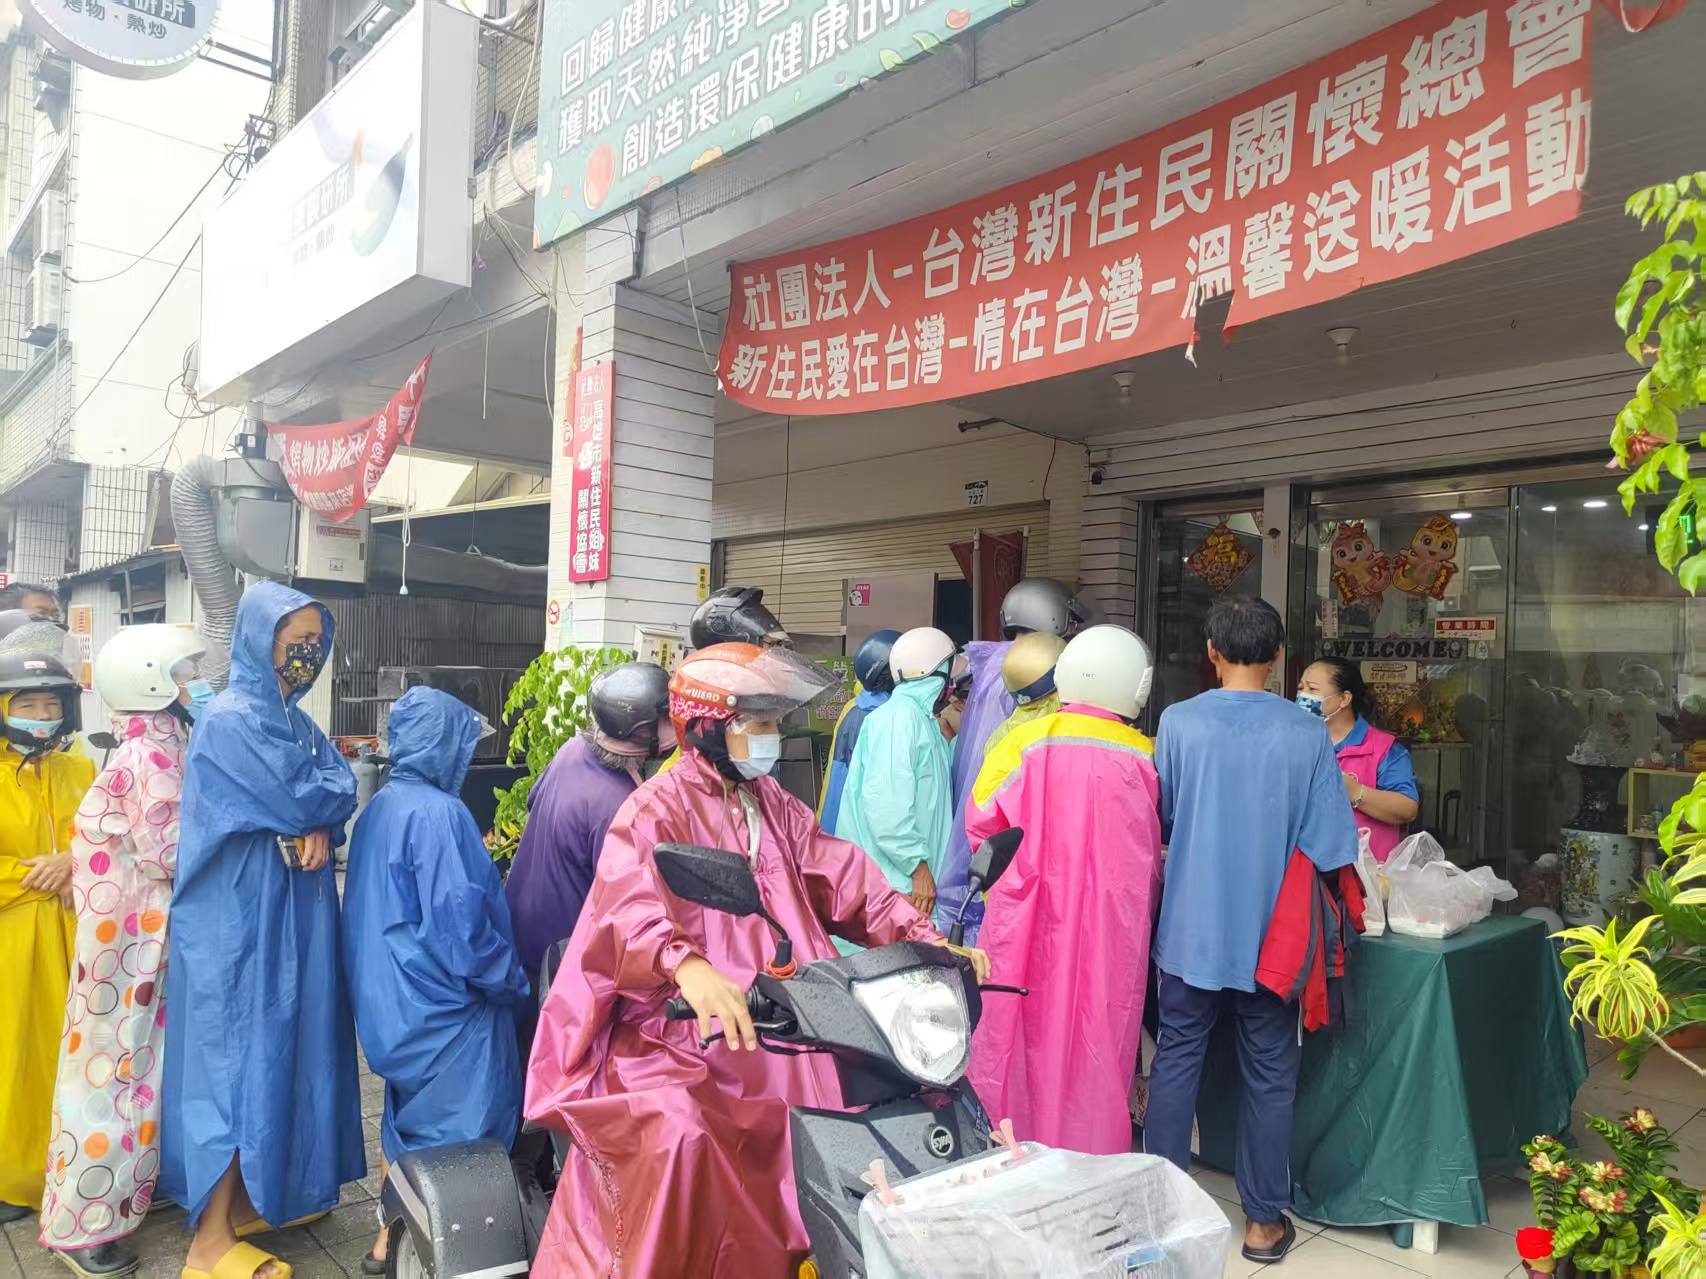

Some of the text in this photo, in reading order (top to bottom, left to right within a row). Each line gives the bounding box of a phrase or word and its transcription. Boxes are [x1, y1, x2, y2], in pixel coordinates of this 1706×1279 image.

[561, 0, 696, 96] 回歸健康
[621, 0, 929, 177] 創造環保健康的
[968, 494, 984, 504] 727
[1333, 640, 1448, 658] WELCOME
